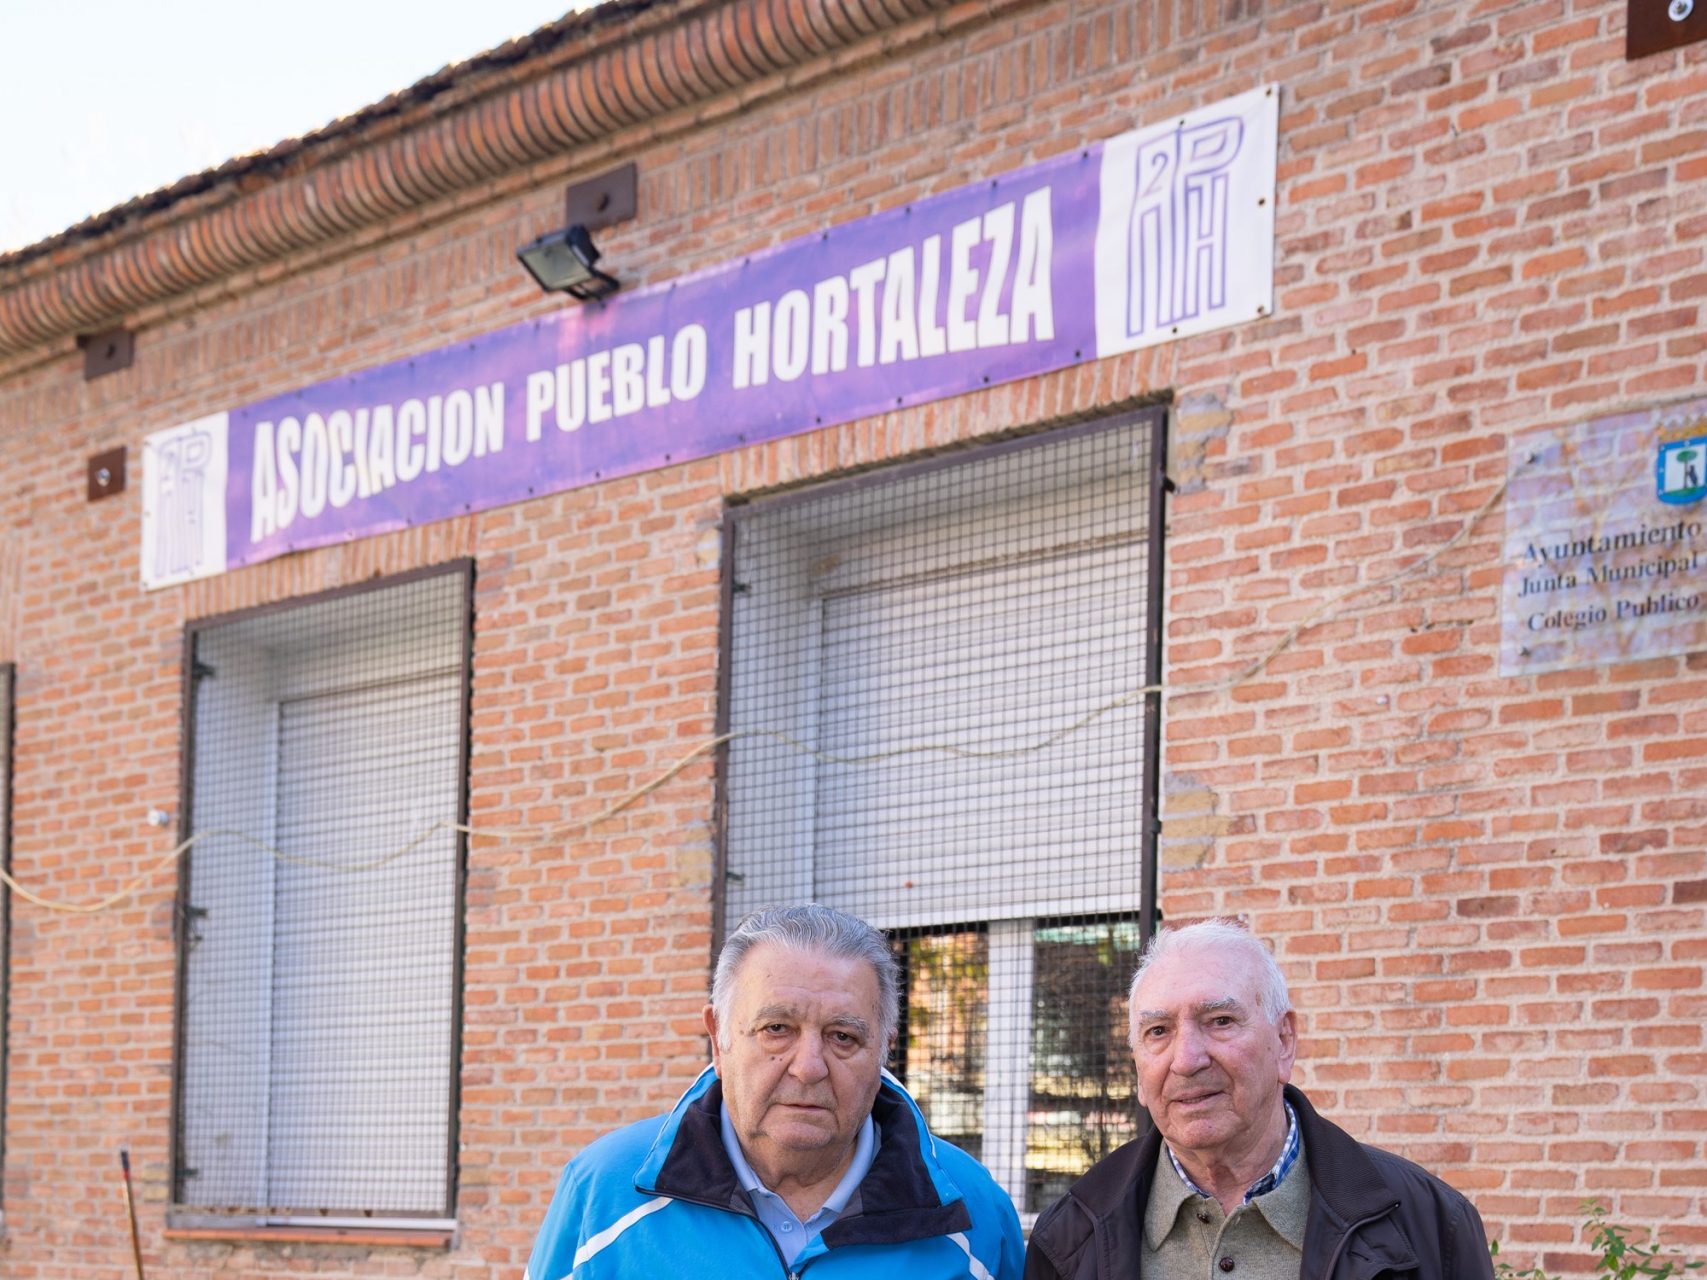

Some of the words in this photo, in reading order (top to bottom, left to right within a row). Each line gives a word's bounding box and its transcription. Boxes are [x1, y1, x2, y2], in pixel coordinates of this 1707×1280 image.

[250, 382, 505, 544] ASOCIACION
[526, 323, 707, 442] PUEBLO
[733, 185, 1055, 390] HORTALEZA
[1524, 521, 1702, 569] Ayuntamiento
[1517, 573, 1577, 598] Junta
[1586, 549, 1698, 588] Municipal
[1527, 604, 1608, 632] Colegio
